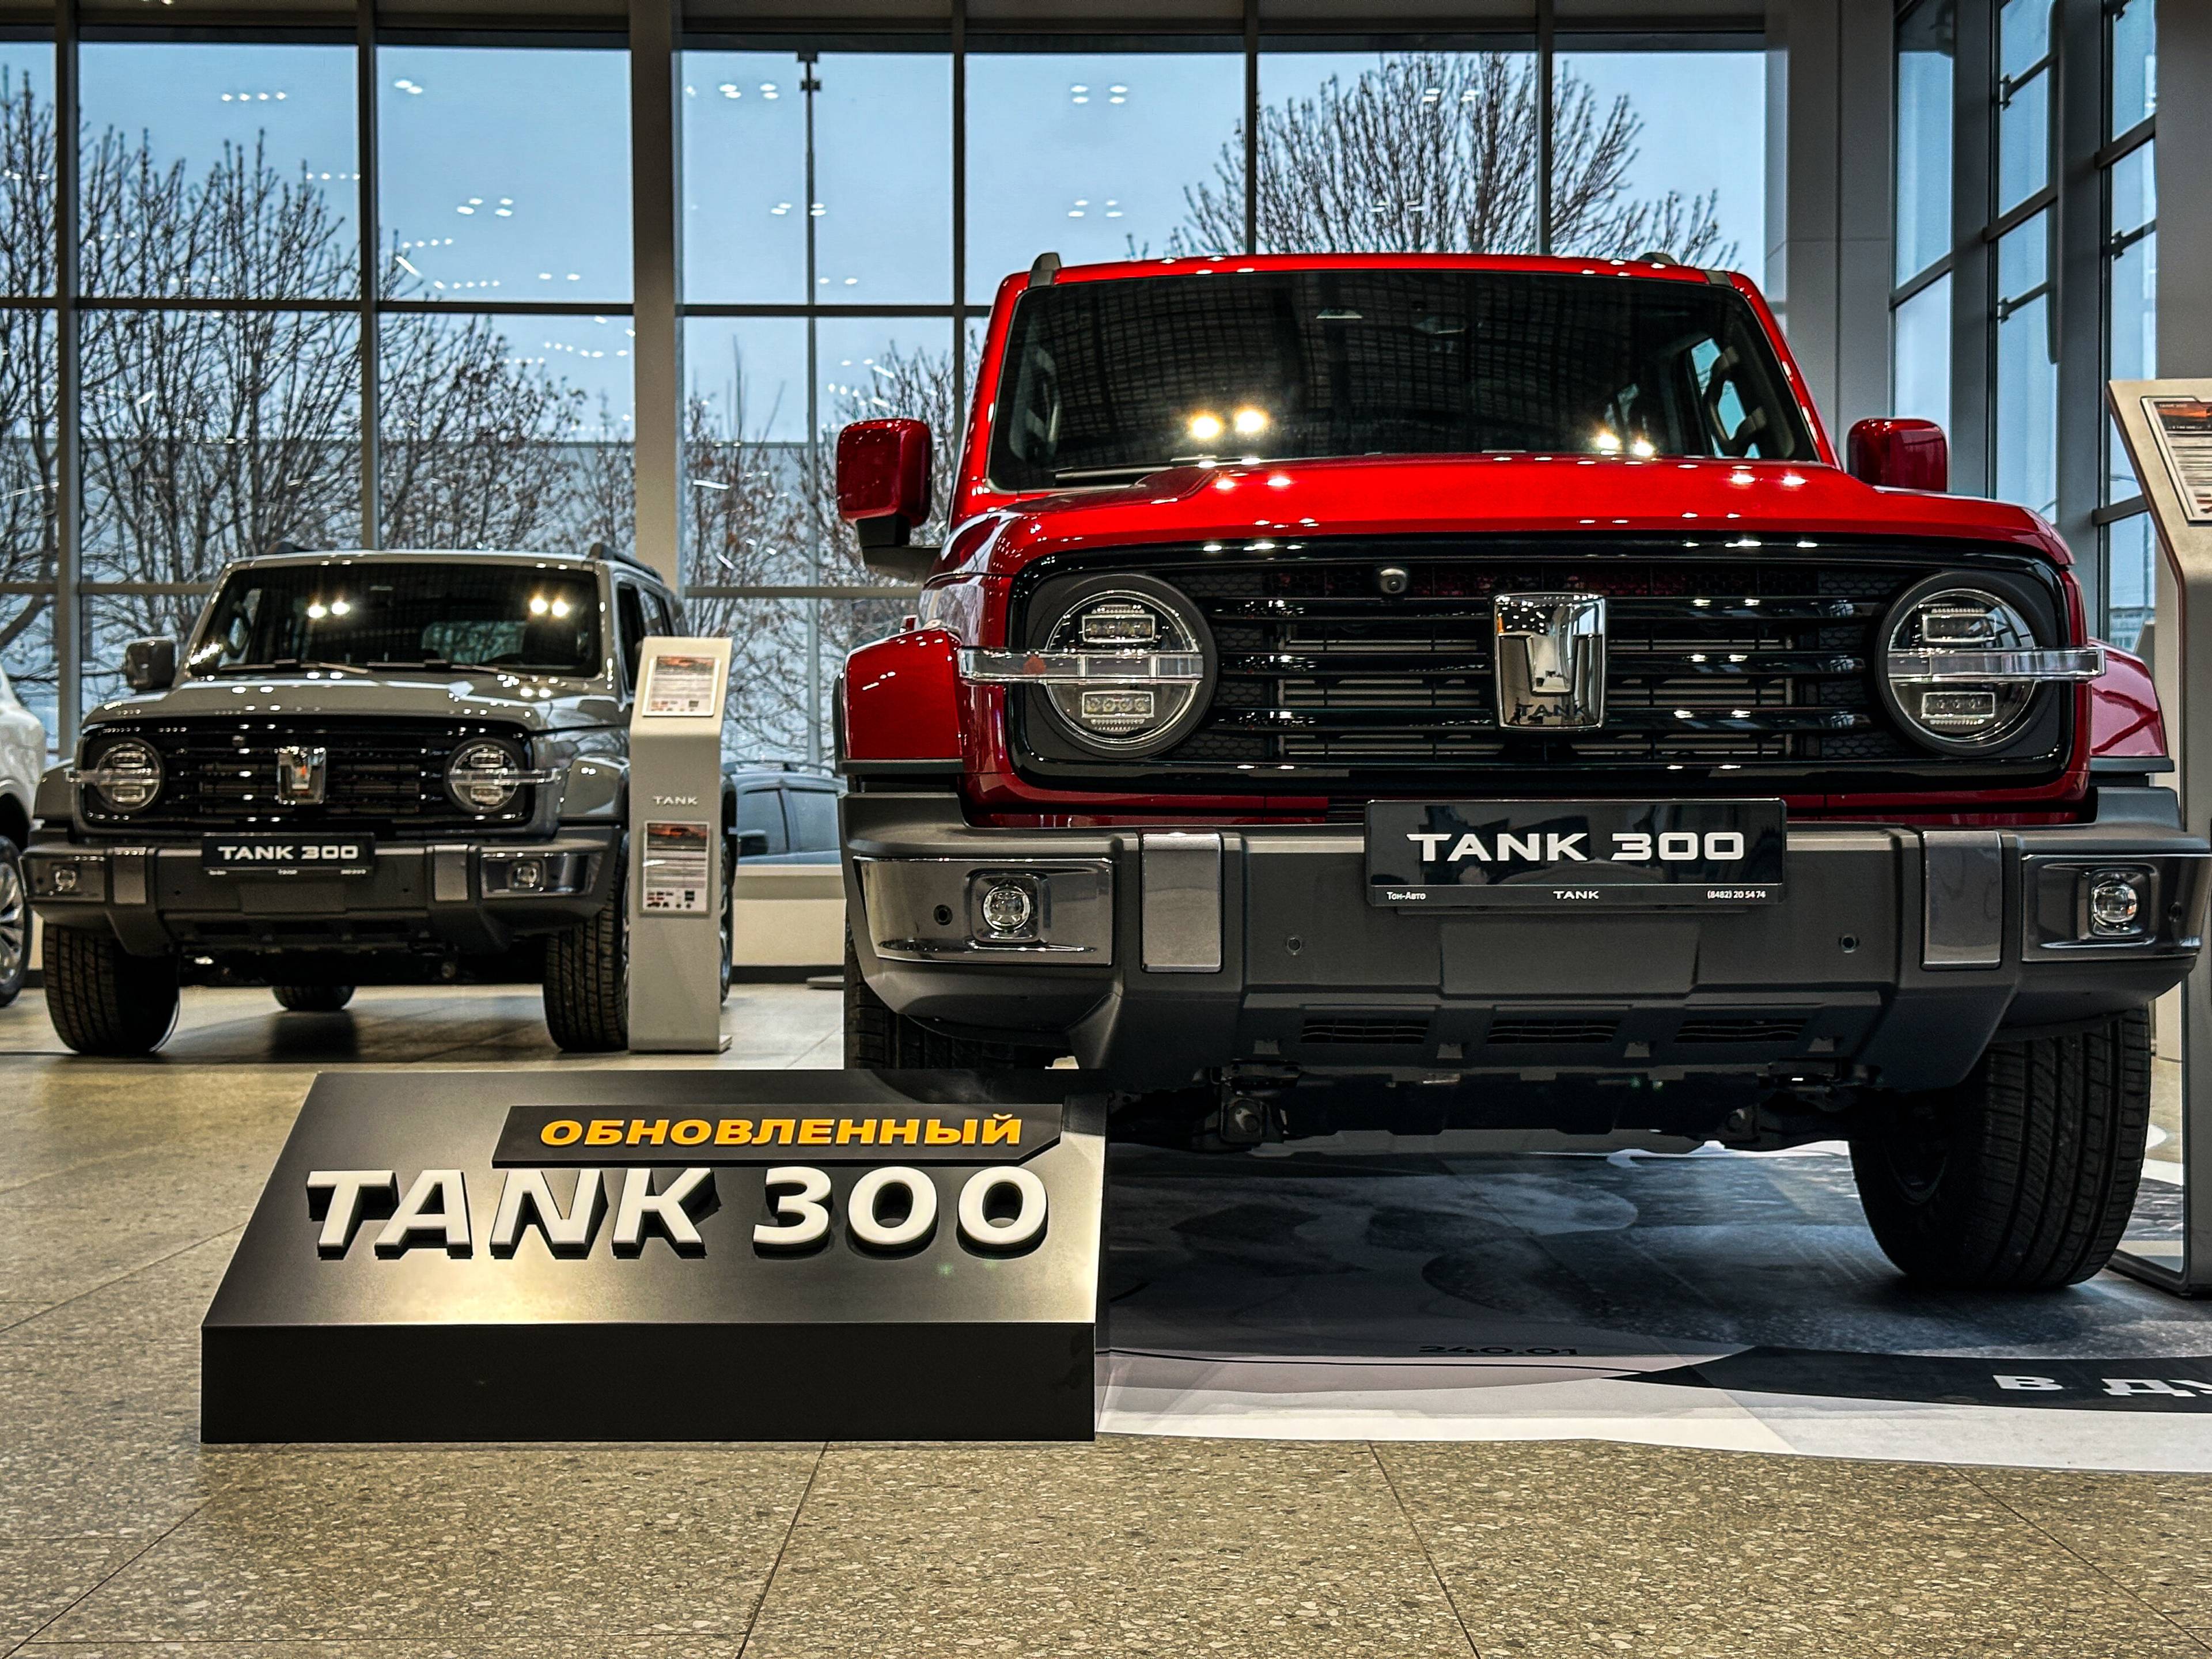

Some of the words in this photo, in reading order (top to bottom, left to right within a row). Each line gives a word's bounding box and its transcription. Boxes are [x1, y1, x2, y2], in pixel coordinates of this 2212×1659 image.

[653, 796, 698, 805] TANK
[217, 846, 294, 860] TANK
[301, 845, 358, 859] 300
[1406, 833, 1588, 862] TANK
[1611, 831, 1745, 861] 300
[1553, 891, 1599, 899] TANK
[1733, 891, 1744, 899] 20
[540, 1113, 1022, 1146] ОБНОВЛЕННЫЙ
[305, 1168, 714, 1256] TANK
[752, 1165, 1048, 1255] 300
[1993, 1374, 2063, 1391] В
